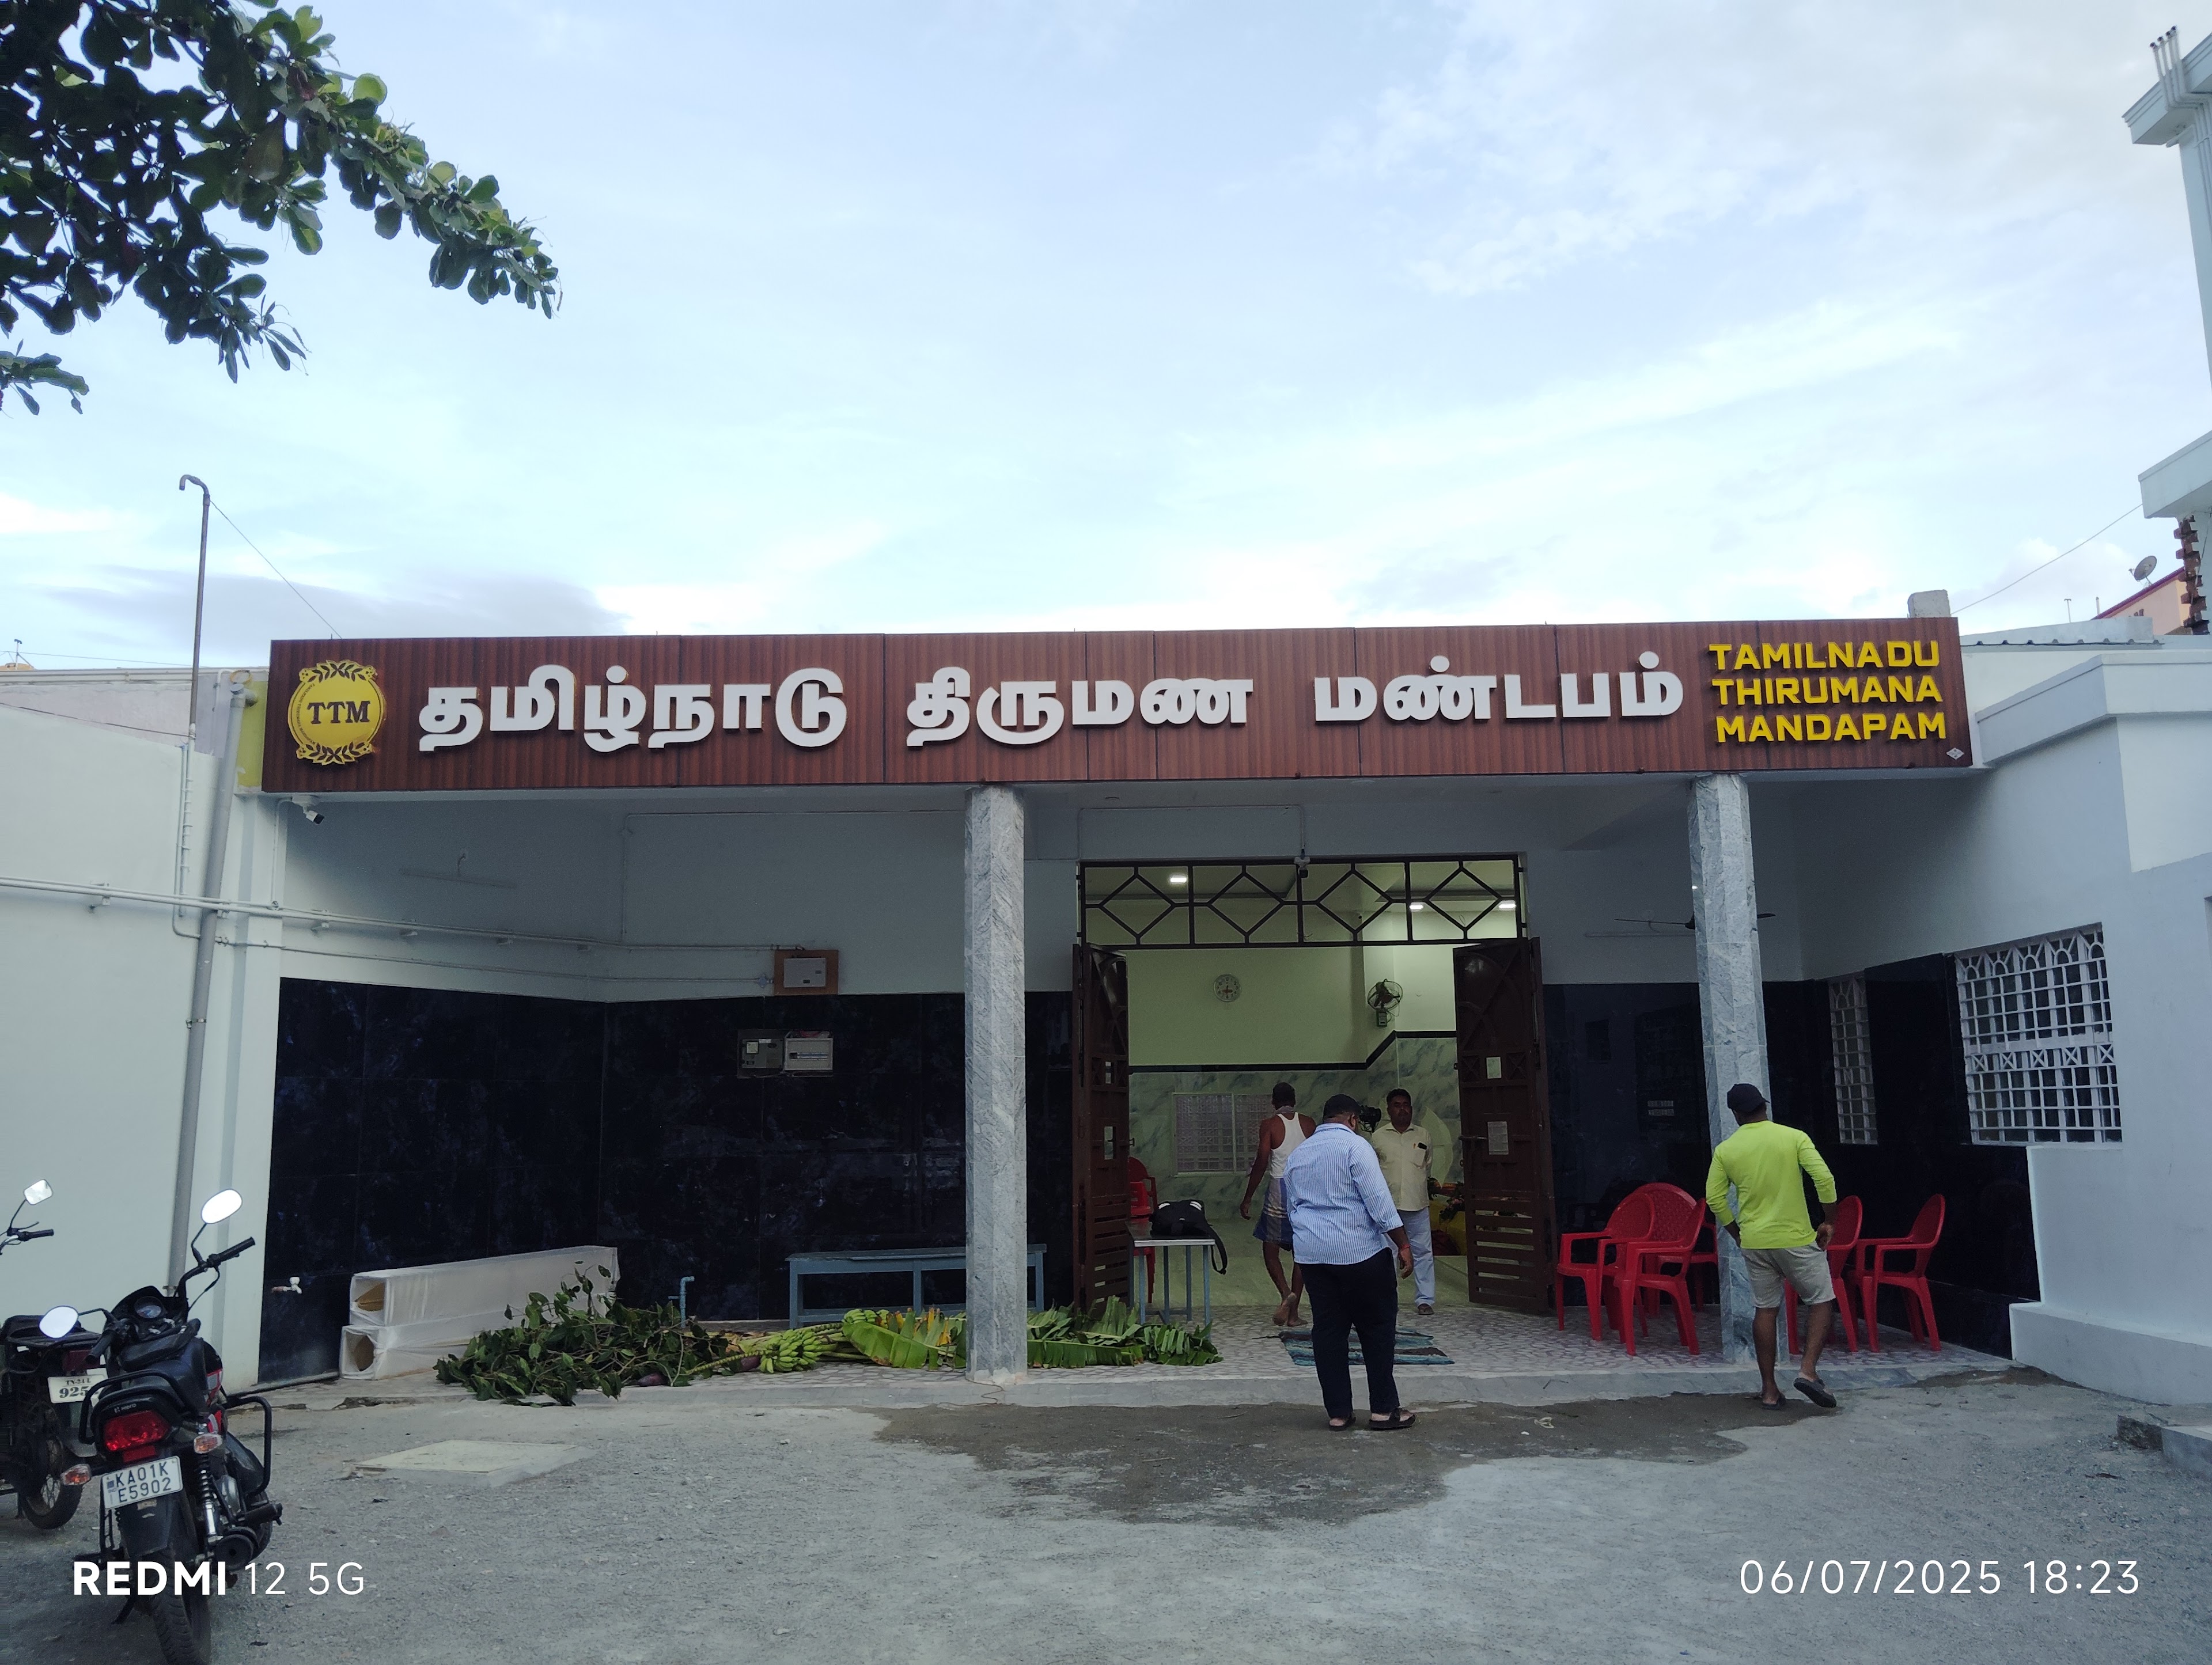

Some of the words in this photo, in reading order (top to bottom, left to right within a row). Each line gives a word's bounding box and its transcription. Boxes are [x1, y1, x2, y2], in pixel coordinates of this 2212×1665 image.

[1708, 640, 1940, 670] TAMILNADU
[418, 664, 848, 752] தமிழ்நாடு
[906, 666, 1254, 747] திருமண
[1313, 650, 1684, 722] மண்டபம்
[1711, 674, 1943, 706] THIRUMANA
[306, 700, 371, 725] TTM
[1715, 711, 1946, 743] MANDAPAM
[115, 1461, 169, 1488] KA01K
[118, 1477, 172, 1503] E5902
